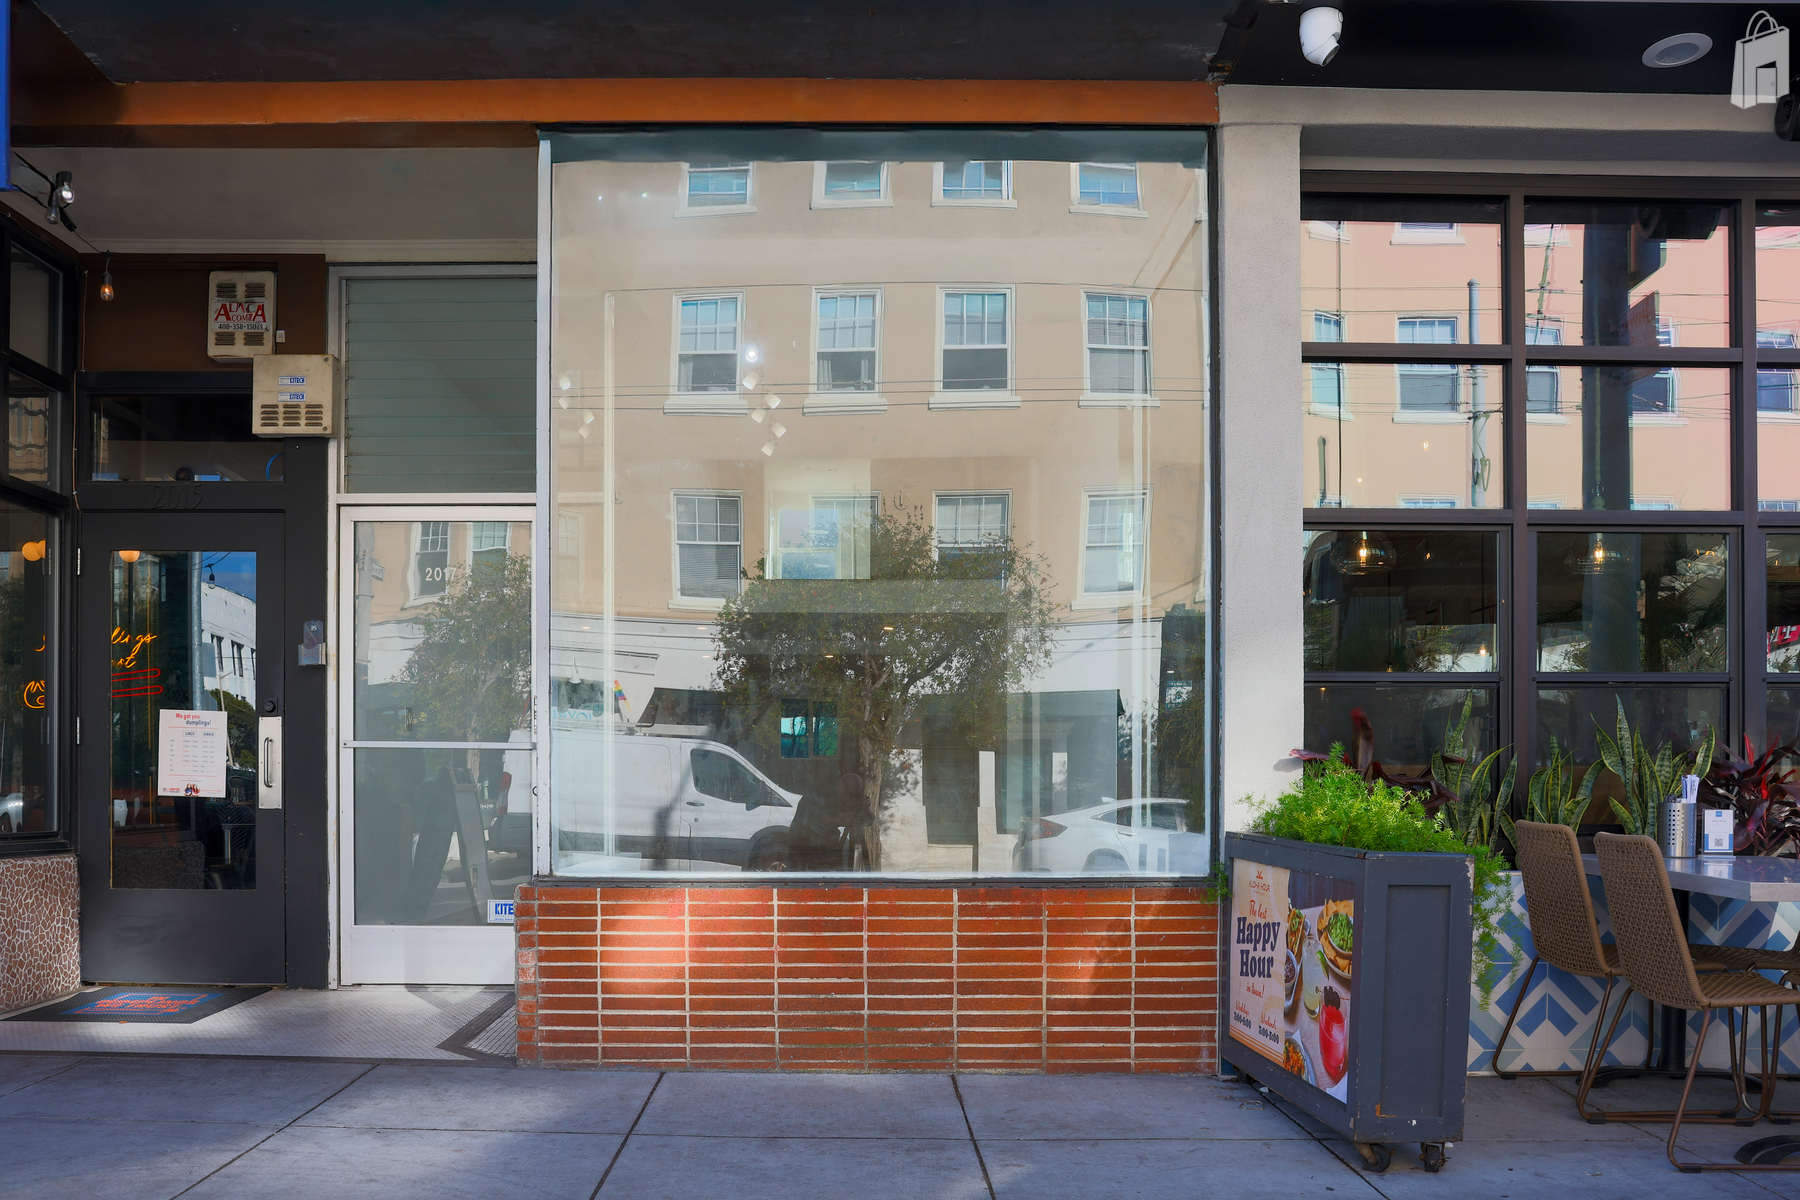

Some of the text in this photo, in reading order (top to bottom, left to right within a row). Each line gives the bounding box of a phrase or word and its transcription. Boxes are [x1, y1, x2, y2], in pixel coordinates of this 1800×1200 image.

[152, 484, 204, 509] 2015
[425, 567, 457, 581] 2017
[495, 903, 514, 915] KITE
[1249, 899, 1268, 919] The best
[1236, 917, 1281, 951] Happy
[1240, 950, 1274, 978] Hour
[1246, 981, 1252, 993] in
